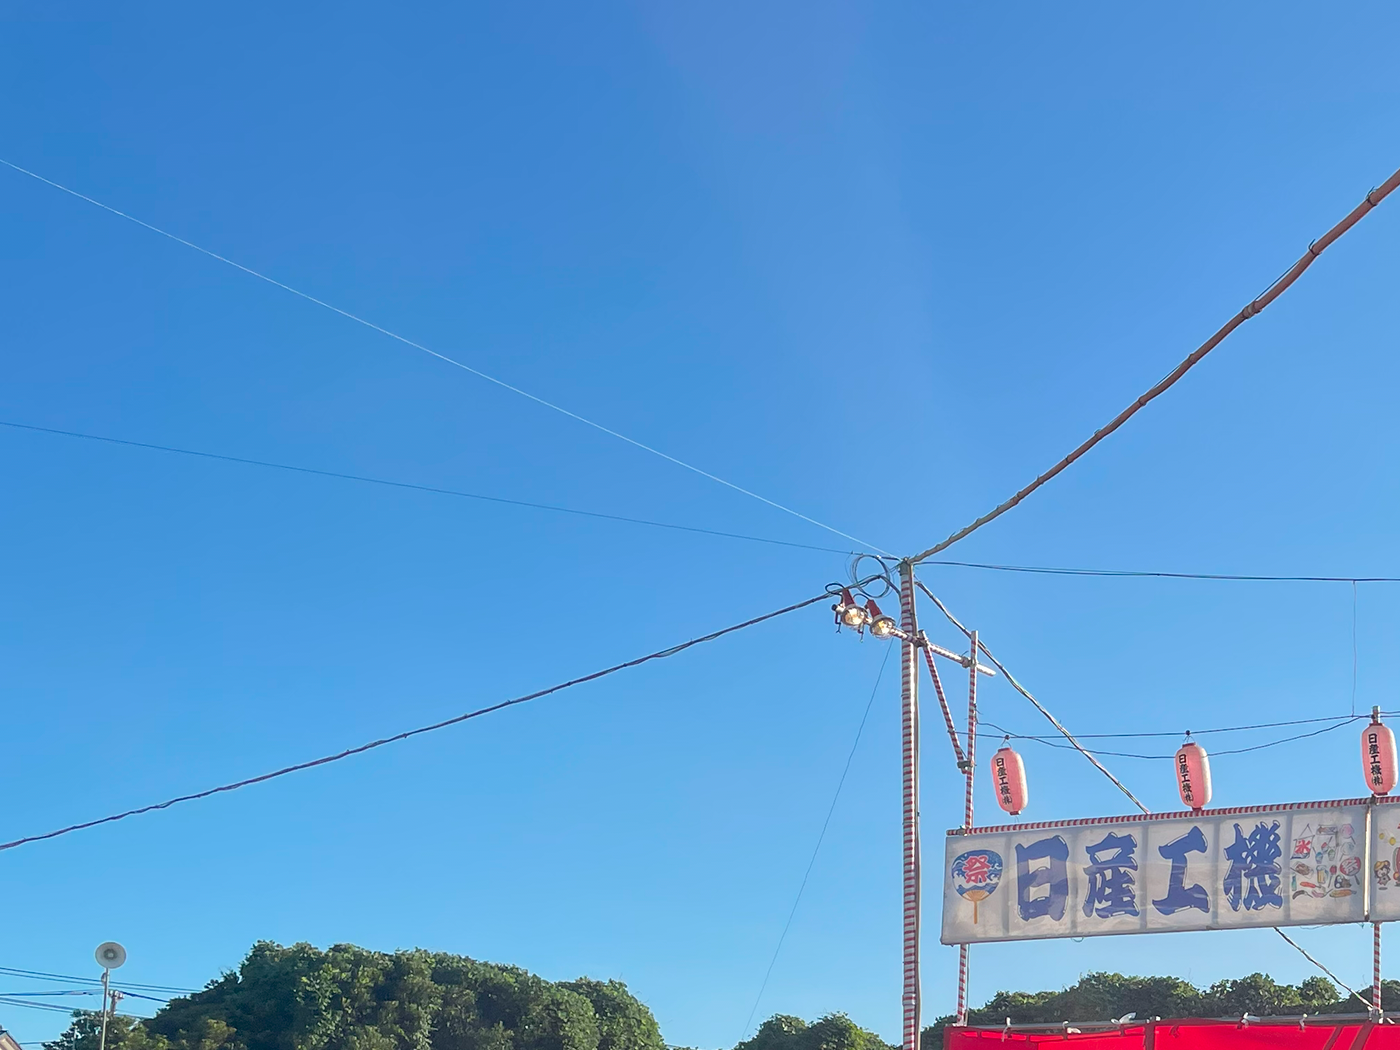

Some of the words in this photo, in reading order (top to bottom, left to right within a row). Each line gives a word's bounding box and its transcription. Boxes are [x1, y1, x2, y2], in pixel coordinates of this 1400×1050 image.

[1295, 840, 1311, 853] 氷
[962, 854, 991, 884] 祭
[1014, 820, 1283, 922] 日産工機
